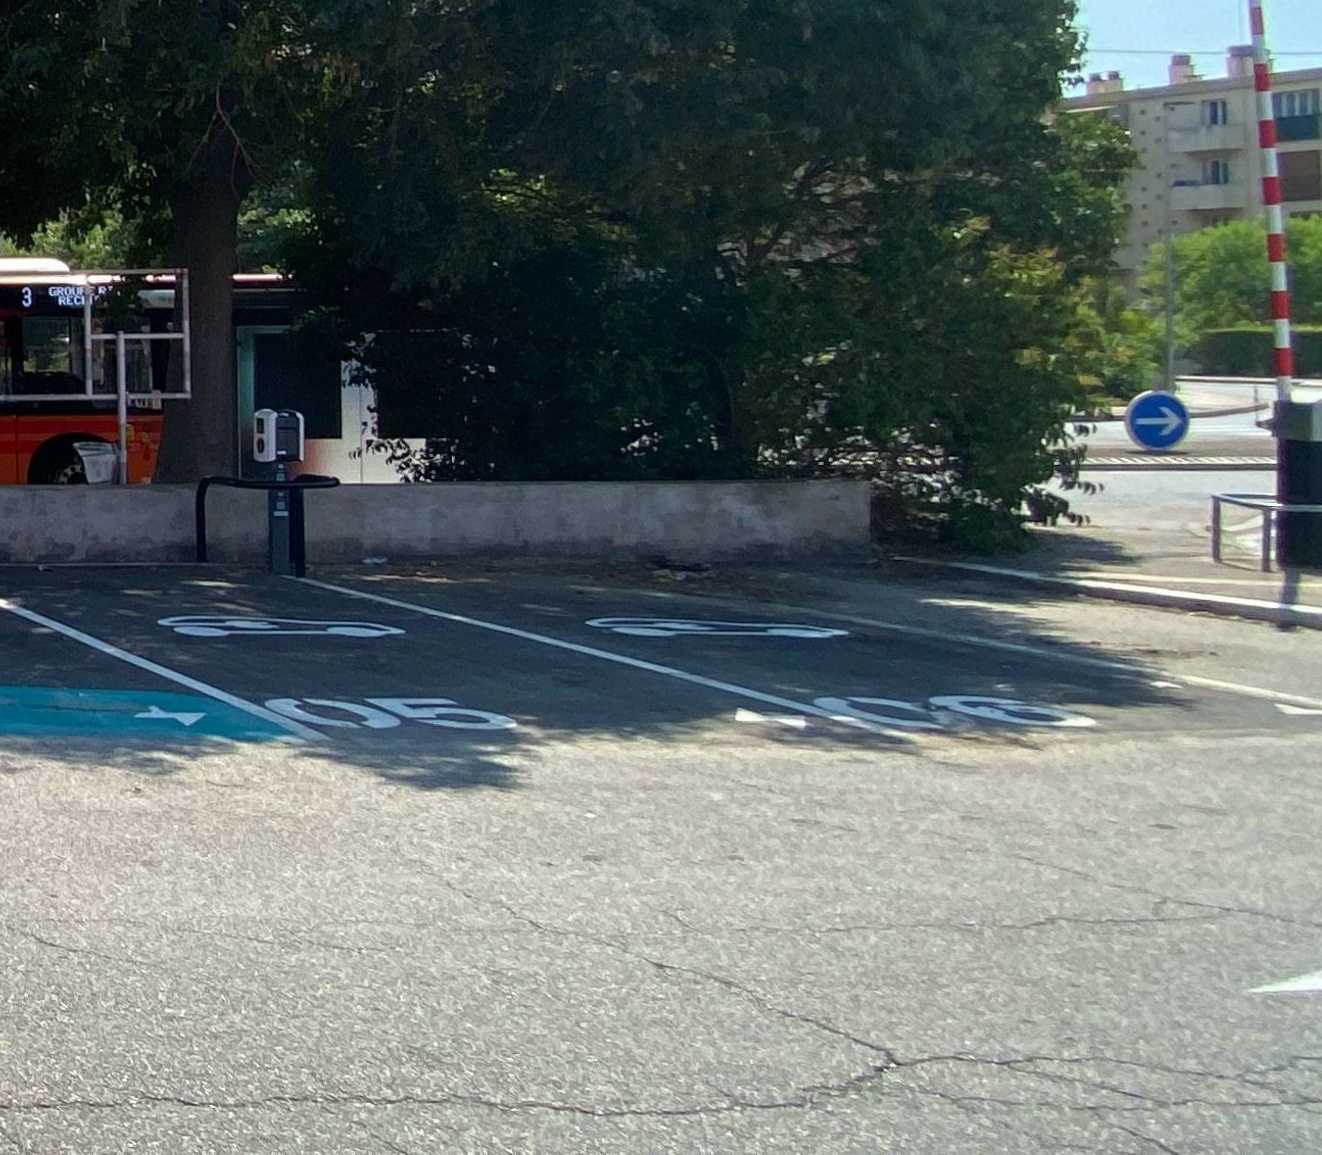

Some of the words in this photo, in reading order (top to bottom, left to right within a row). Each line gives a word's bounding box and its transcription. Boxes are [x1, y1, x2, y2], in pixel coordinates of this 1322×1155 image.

[21, 286, 32, 307] 3
[265, 697, 517, 731] 05
[812, 695, 1098, 729] 06
